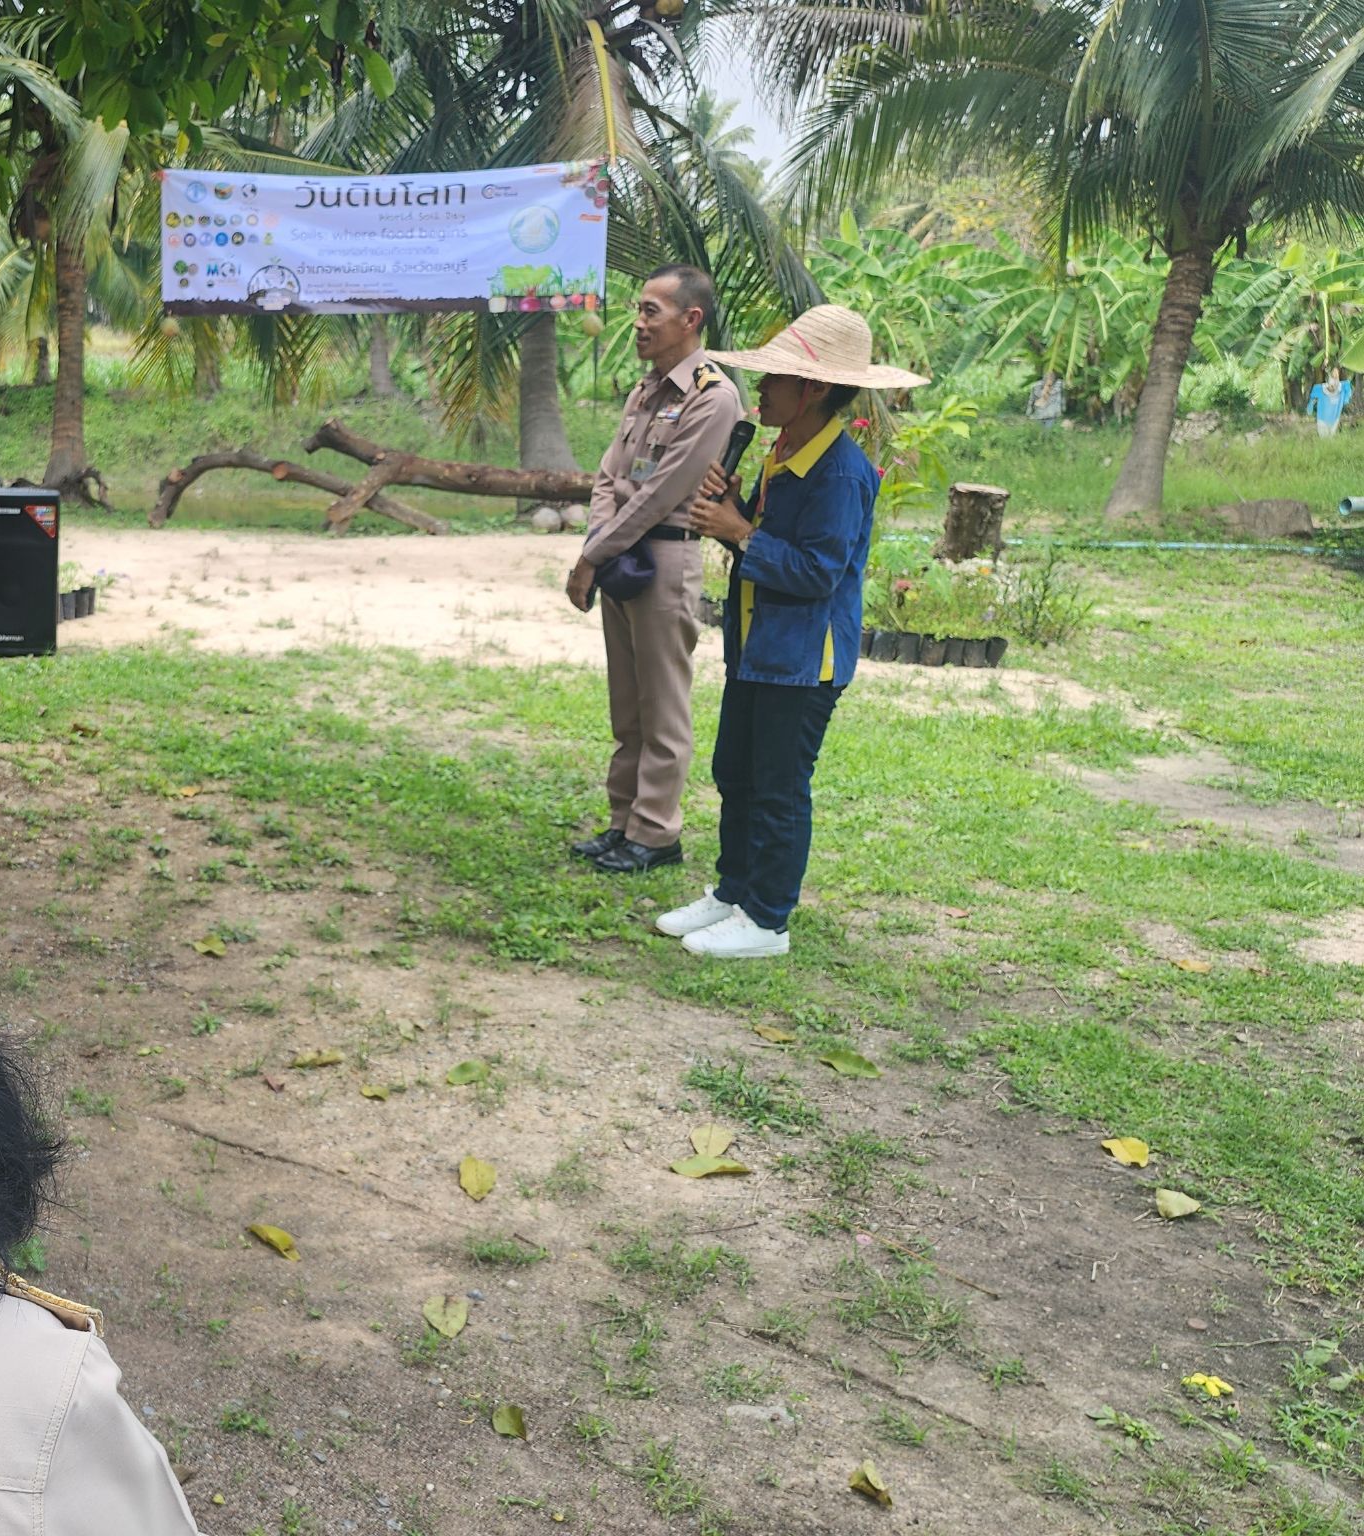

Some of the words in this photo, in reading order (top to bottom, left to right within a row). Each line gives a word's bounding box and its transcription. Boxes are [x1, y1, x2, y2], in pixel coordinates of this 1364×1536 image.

[294, 180, 466, 208] วันดินโลก
[380, 227, 415, 240] food
